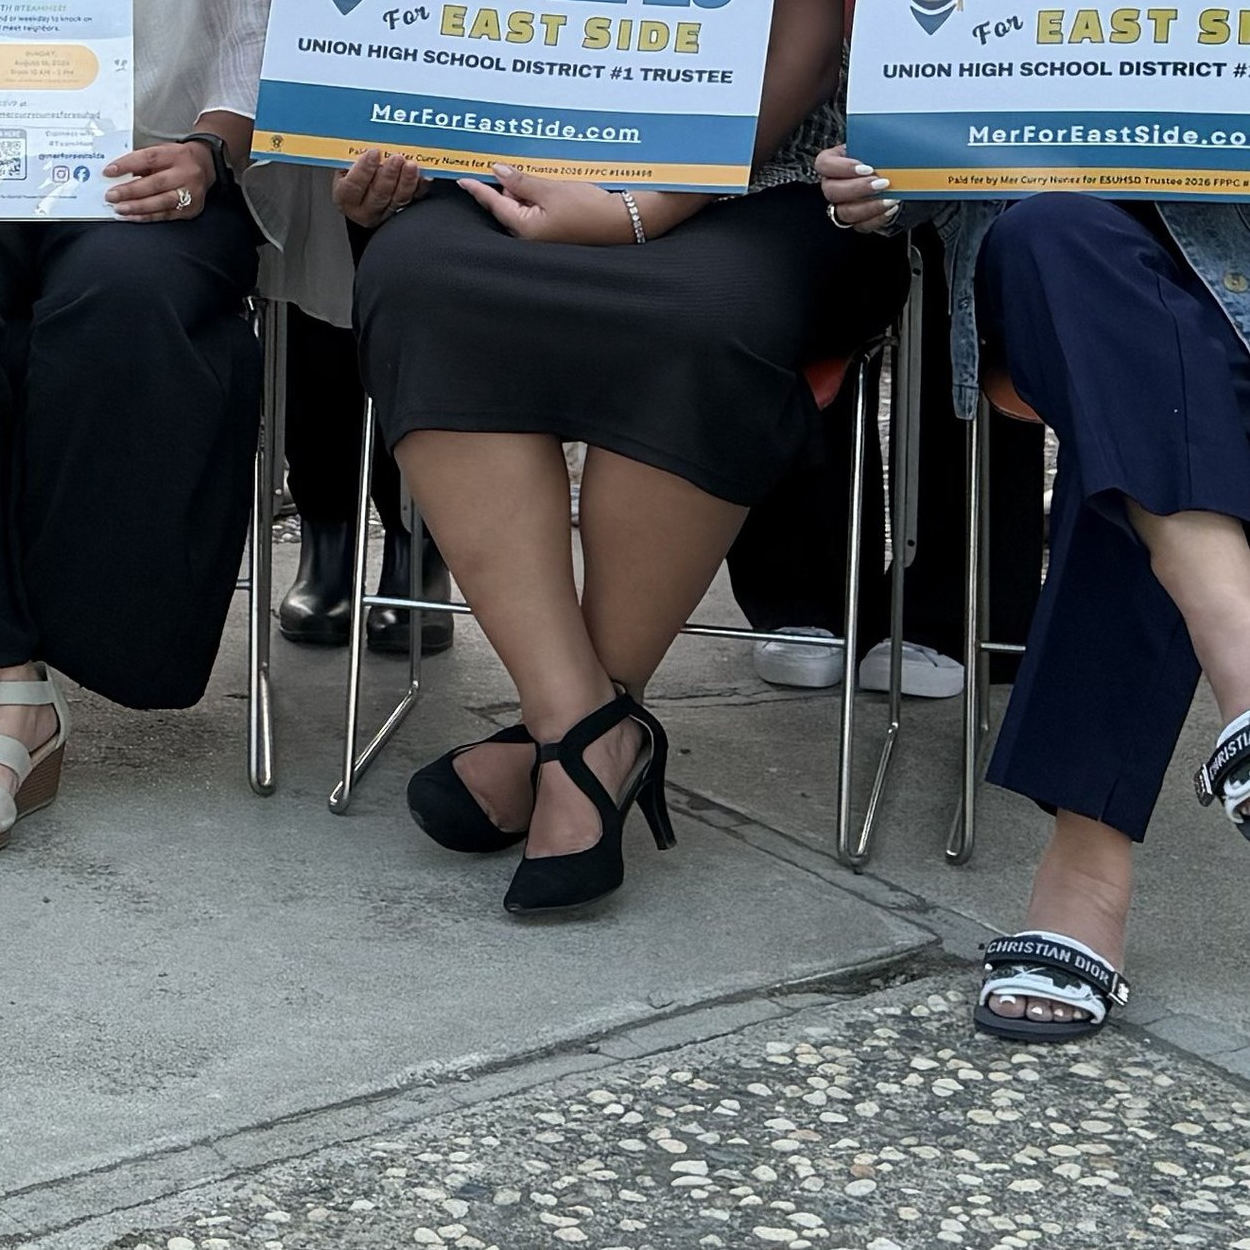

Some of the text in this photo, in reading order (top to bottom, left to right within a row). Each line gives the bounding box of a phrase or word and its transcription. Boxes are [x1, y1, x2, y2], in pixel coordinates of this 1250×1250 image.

[383, 5, 702, 54] For EAST SIDE
[972, 9, 1178, 46] For EAST
[298, 38, 733, 84] UNION HIGH SCHOOL DISTRICT #1 TRUSTEE
[883, 61, 1226, 78] UNION HIGH SCHOOL DISTRICT
[372, 104, 640, 143] MerForEastSide.com
[968, 125, 1250, 147] MerForEastSide.co
[986, 175, 997, 185] by
[1001, 176, 1018, 184] Mer
[1021, 176, 1047, 185] Curry
[1083, 175, 1096, 183] for
[1145, 176, 1182, 185] Trustee
[1214, 178, 1240, 186] FPPC
[988, 941, 1109, 985] CHRISTIAN DIOR
